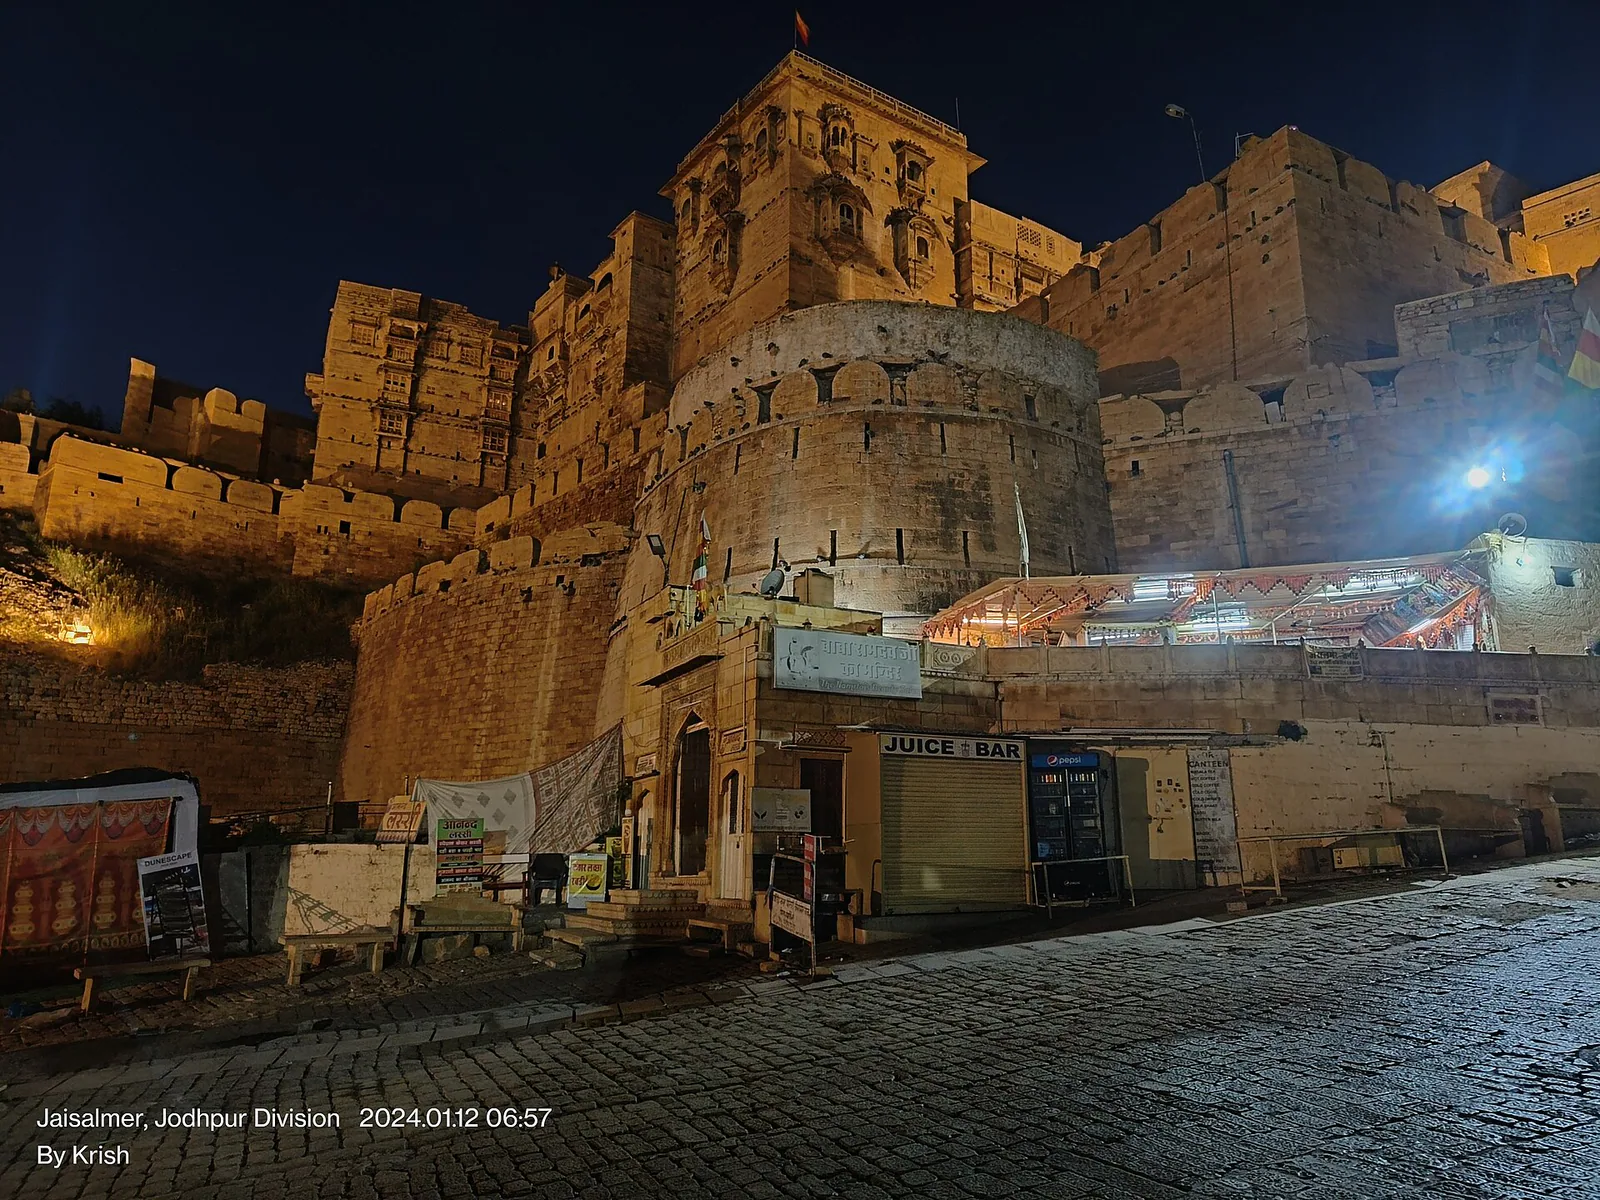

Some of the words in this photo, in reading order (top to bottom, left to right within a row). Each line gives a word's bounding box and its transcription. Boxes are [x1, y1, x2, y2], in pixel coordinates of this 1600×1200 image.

[885, 737, 955, 755] JUICE
[975, 742, 1021, 759] BAR
[1058, 755, 1082, 765] pepsi
[1189, 760, 1229, 768] CANTEEN
[443, 820, 478, 830] आनन्द
[449, 830, 472, 839] लस्सी
[144, 851, 193, 867] DUNESCAPE
